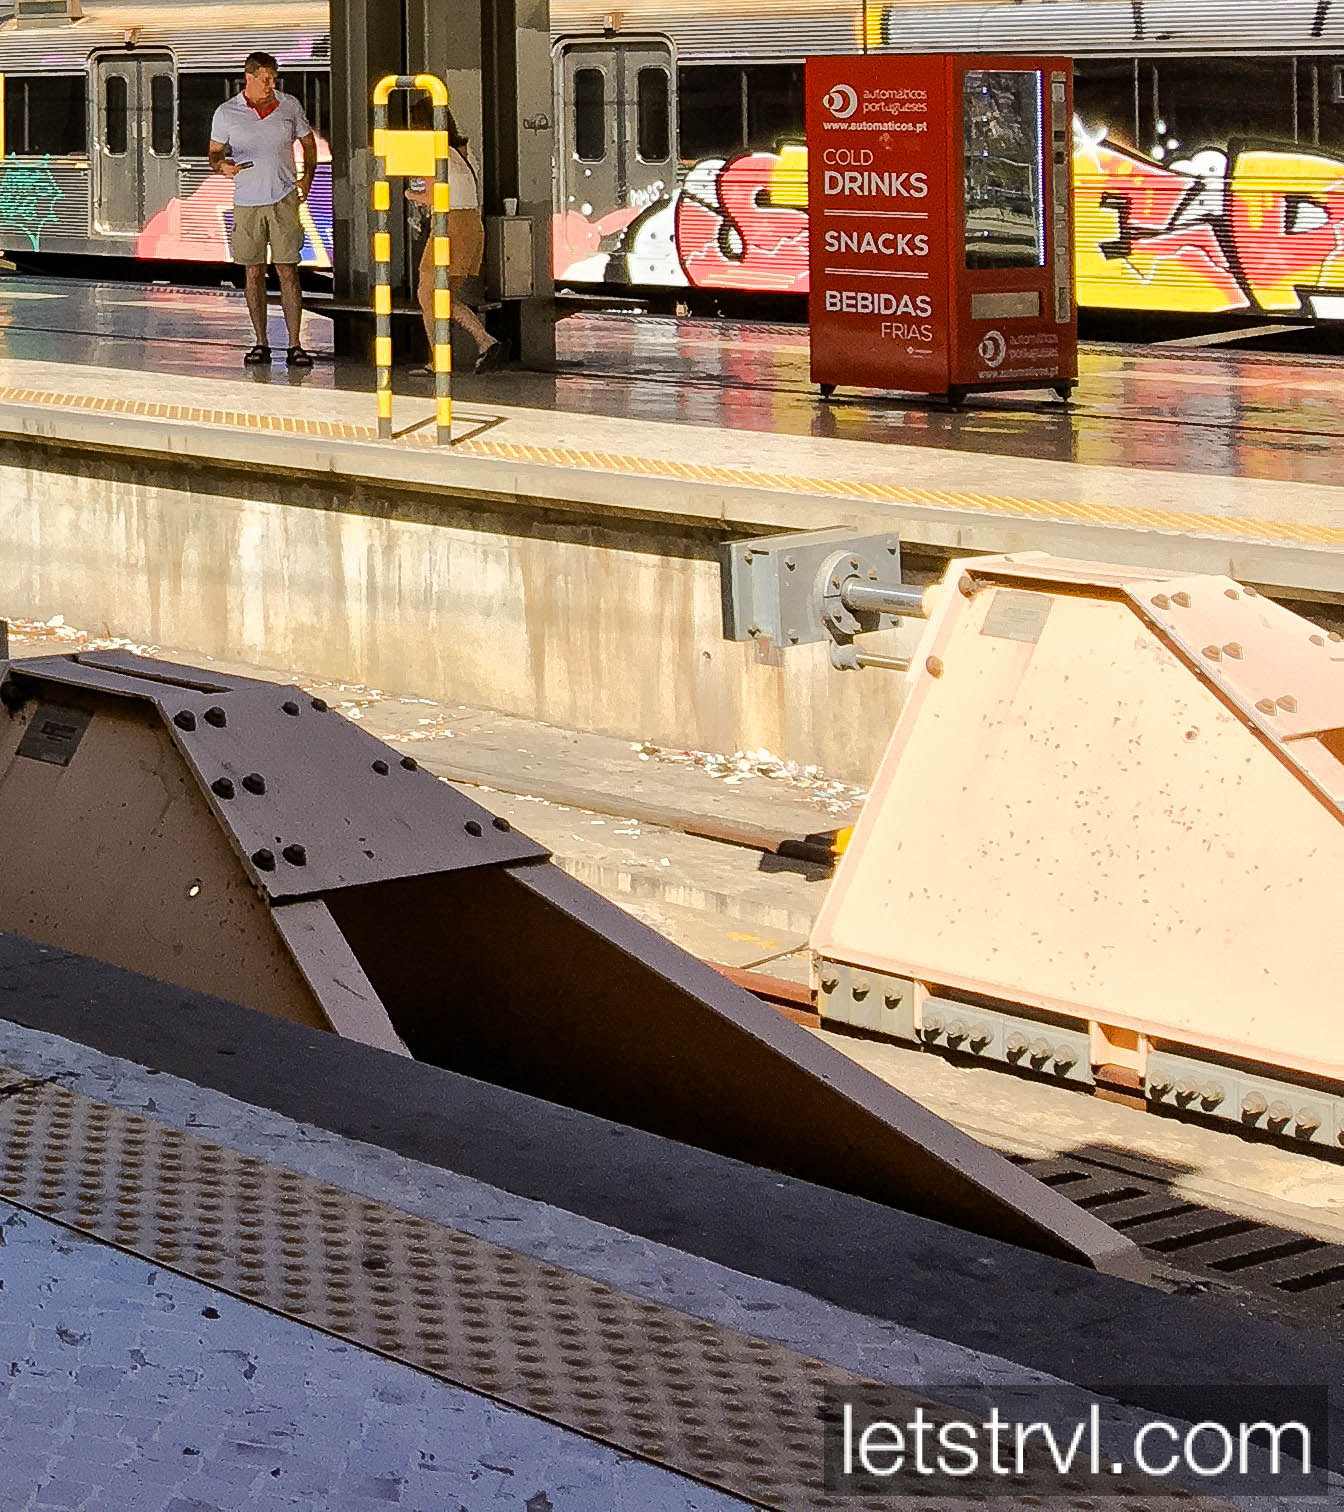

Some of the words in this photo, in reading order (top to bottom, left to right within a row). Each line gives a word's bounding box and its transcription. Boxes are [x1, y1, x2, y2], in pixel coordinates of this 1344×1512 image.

[823, 120, 928, 134] www.automaticos.pt
[823, 148, 874, 166] COLD
[823, 171, 929, 198] DRINKS
[824, 231, 929, 256] SNACKS
[825, 290, 933, 318] BEBIDAS
[881, 322, 934, 342] FRIAS
